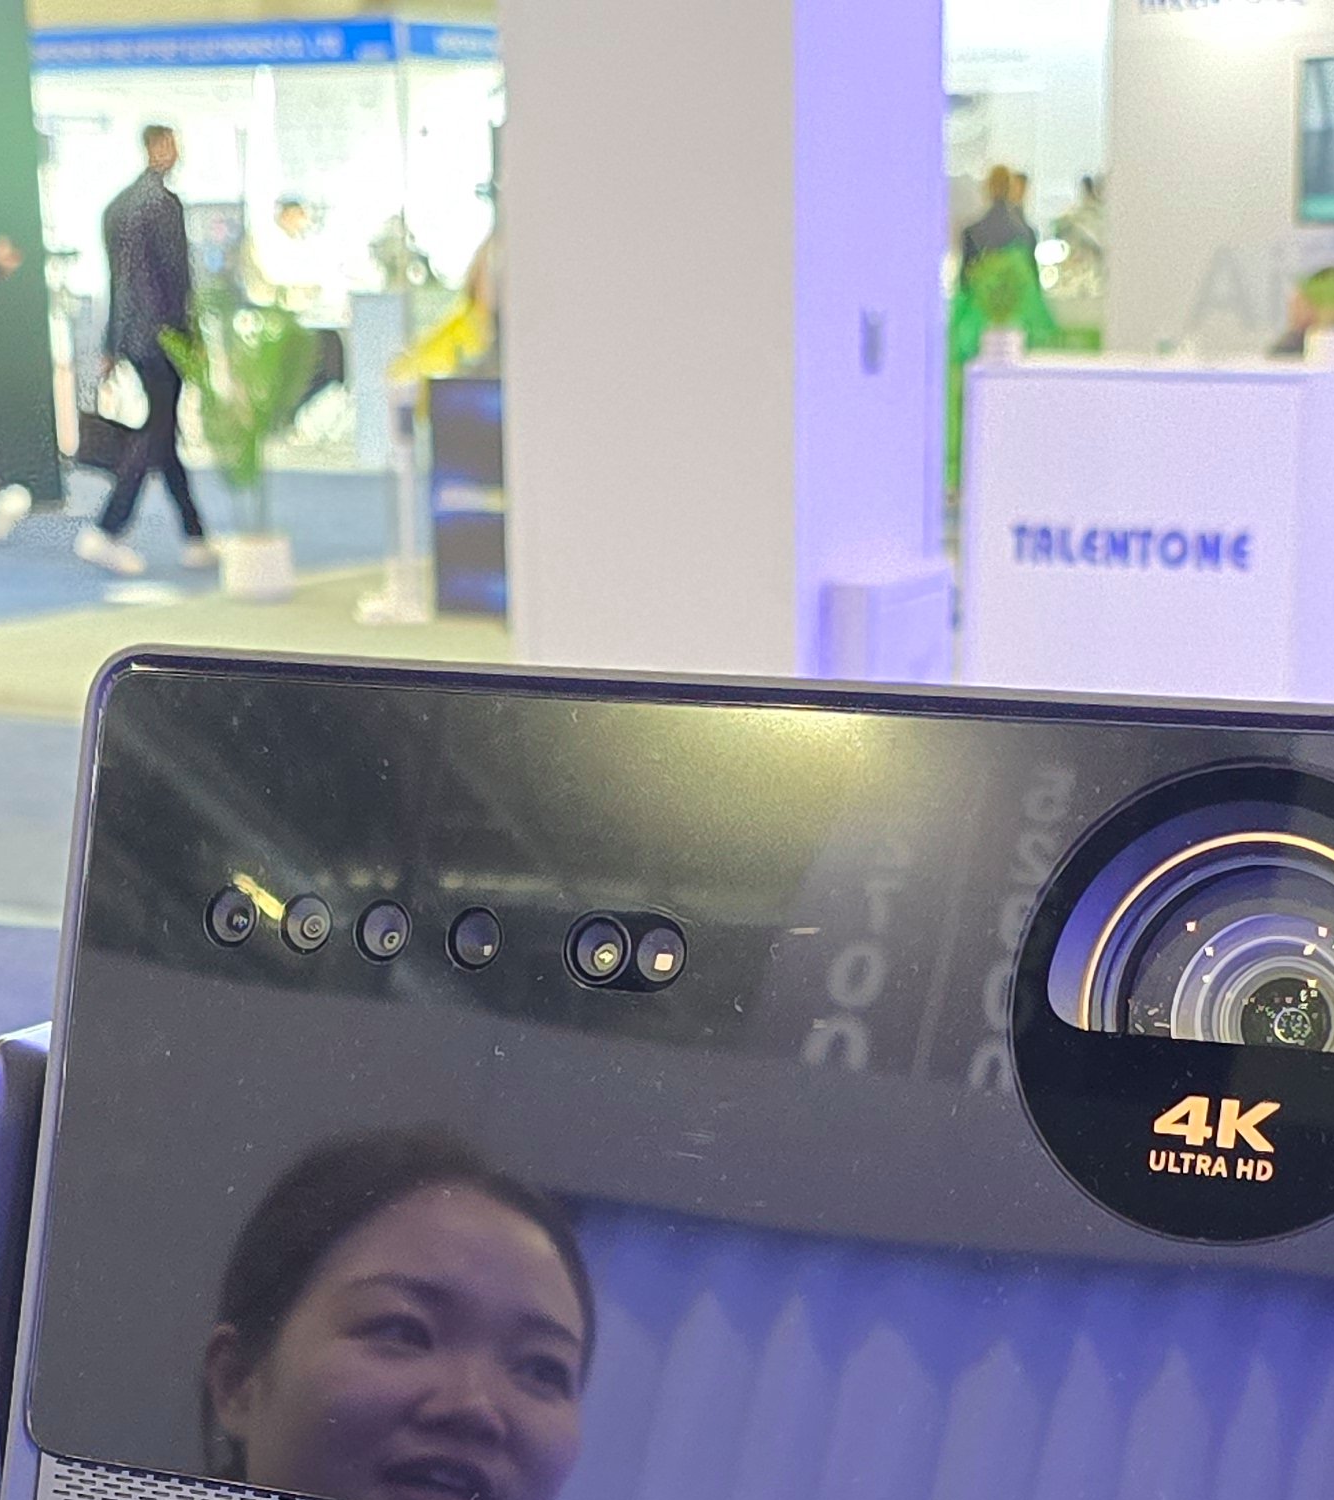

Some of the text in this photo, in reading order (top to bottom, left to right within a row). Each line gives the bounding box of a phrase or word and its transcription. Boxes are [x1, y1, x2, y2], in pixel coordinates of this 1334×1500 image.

[1012, 523, 1250, 571] TALENTONE
[1153, 1095, 1281, 1153] 4K
[1149, 1149, 1274, 1182] ULTRA HD
